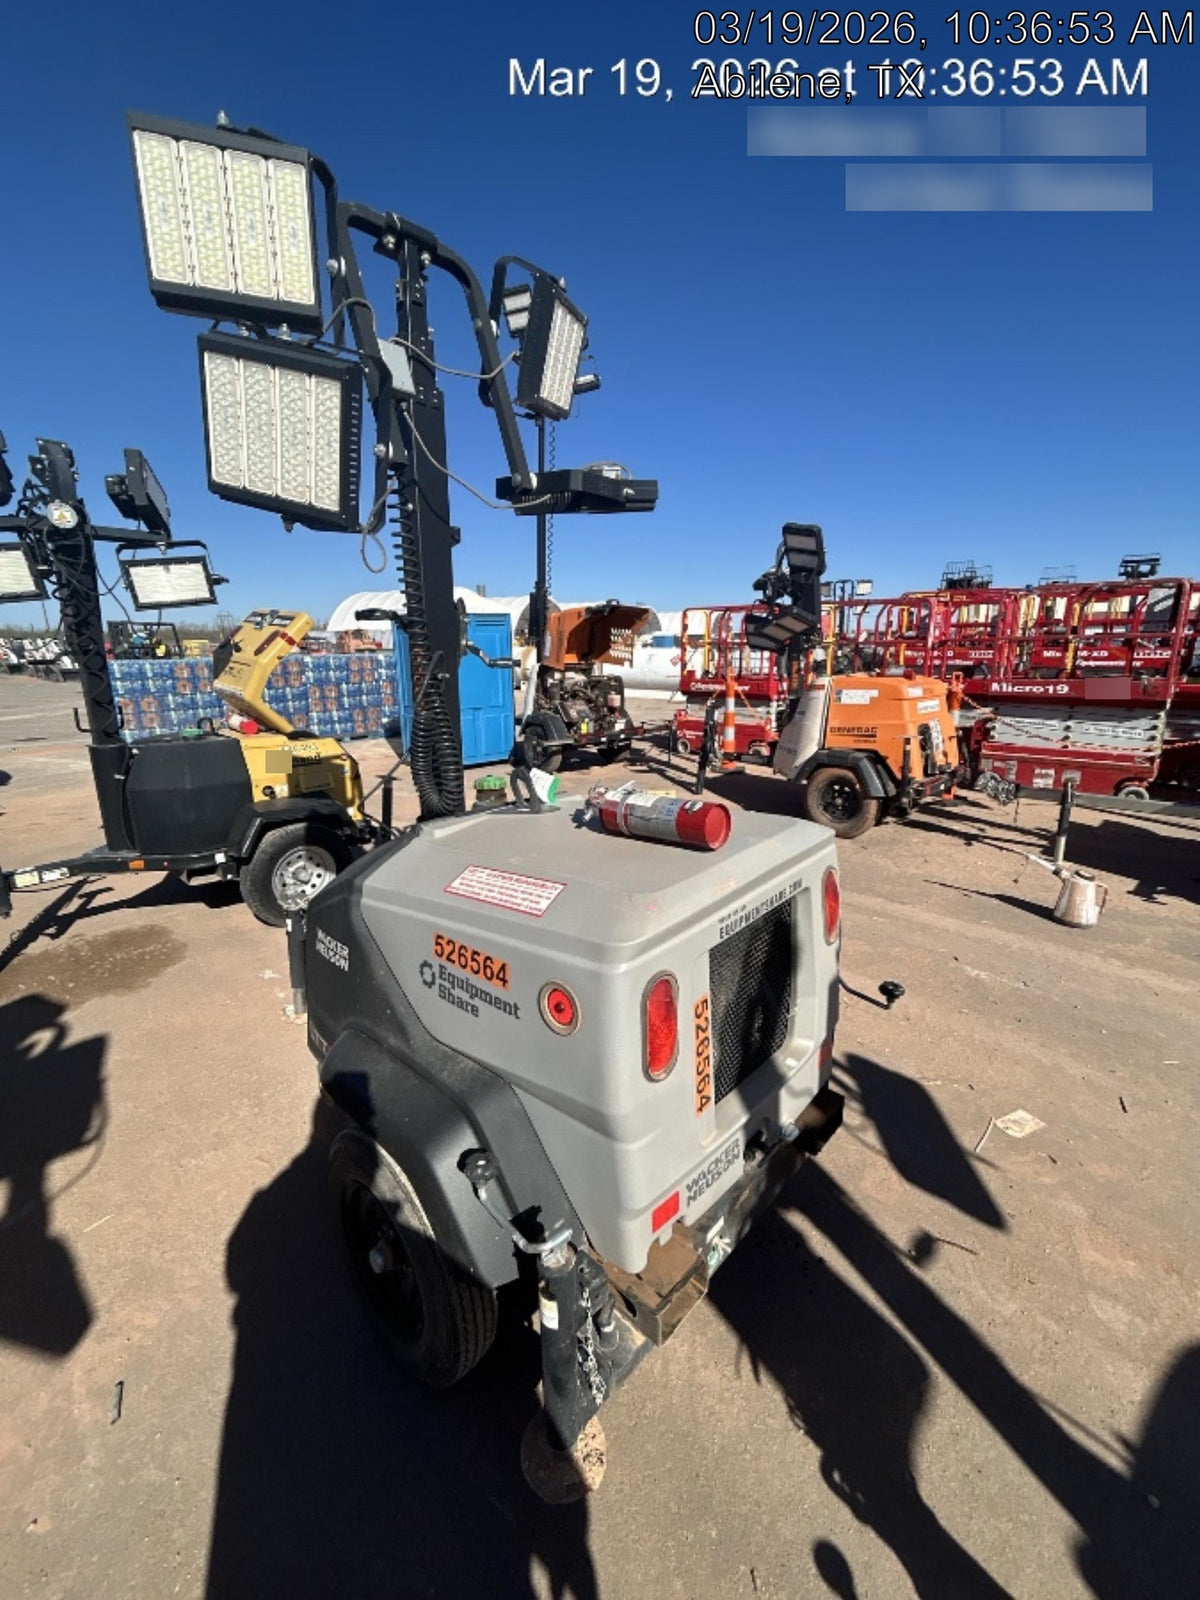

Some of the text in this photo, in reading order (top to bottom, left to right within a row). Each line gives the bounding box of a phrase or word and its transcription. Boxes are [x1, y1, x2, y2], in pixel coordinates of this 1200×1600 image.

[316, 926, 349, 958] WACKER
[434, 934, 510, 988] 526564
[438, 963, 521, 1020] Equipment
[438, 985, 480, 1018] Share
[694, 998, 712, 1113] 526564
[686, 1138, 740, 1193] WACKER
[686, 1149, 741, 1208] NEUSON
